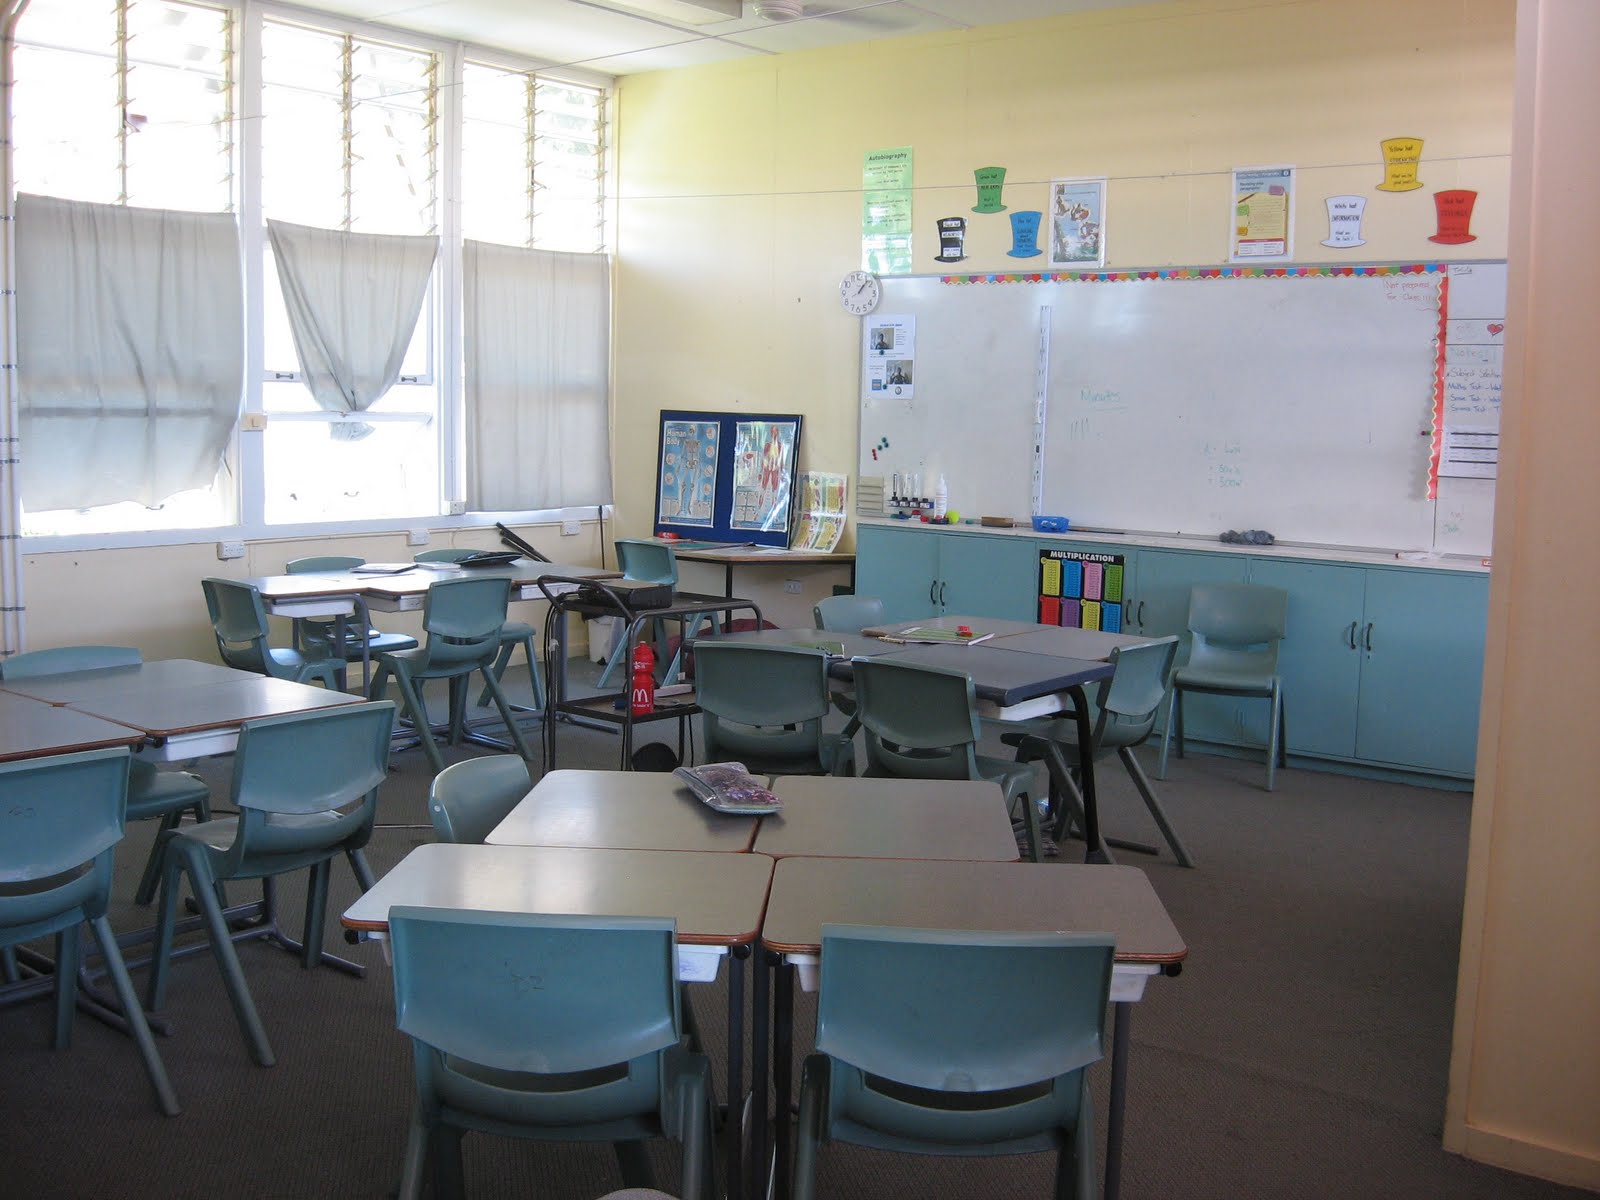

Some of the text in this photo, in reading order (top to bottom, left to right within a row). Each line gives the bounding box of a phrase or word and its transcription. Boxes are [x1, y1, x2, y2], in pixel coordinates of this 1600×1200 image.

[868, 152, 907, 161] Autobiography
[856, 273, 863, 281] 12
[844, 280, 851, 288] 10
[868, 280, 873, 288] 2
[841, 289, 847, 297] 9
[872, 289, 877, 297] 3
[844, 298, 849, 306] 8
[867, 299, 873, 307] 4
[850, 304, 855, 312] 7
[856, 305, 861, 313] 6
[862, 304, 867, 312] 5
[667, 429, 687, 438] Human
[666, 437, 680, 446] Body
[1050, 550, 1115, 563] MULTIPLICATION
